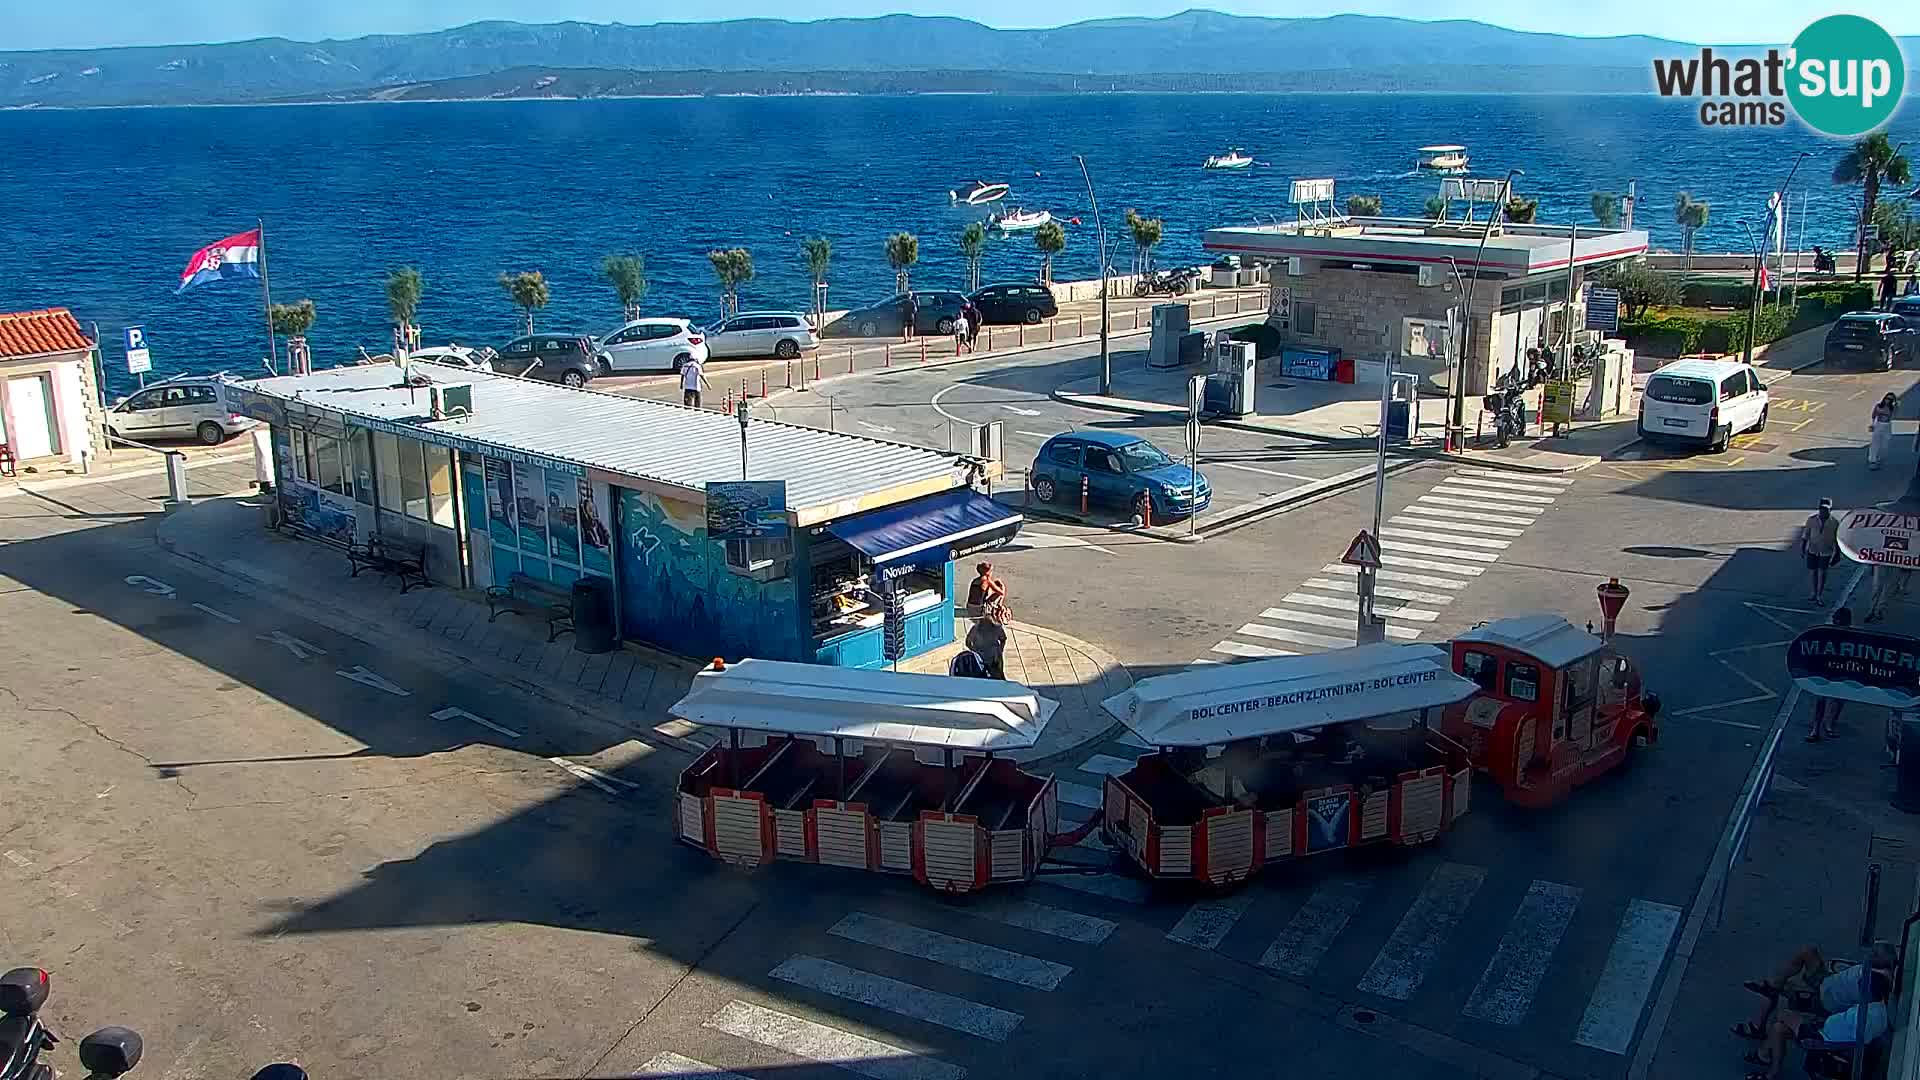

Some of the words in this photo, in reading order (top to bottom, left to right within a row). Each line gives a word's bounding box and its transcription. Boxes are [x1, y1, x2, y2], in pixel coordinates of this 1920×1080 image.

[129, 329, 142, 348] P
[1672, 379, 1691, 387] TAXI
[478, 443, 492, 456] BUS
[494, 447, 526, 465] STATION
[527, 454, 553, 470] TICKET
[554, 460, 583, 476] OFFICE
[1869, 662, 1897, 678] bar
[1191, 706, 1215, 721] BOL
[1216, 699, 1260, 717] CENTER
[1267, 692, 1304, 709] BEACH
[1305, 684, 1345, 702] ZLATNI
[1345, 680, 1365, 694] RAT
[1373, 676, 1395, 691] BOL
[1396, 670, 1437, 686] CENTER
